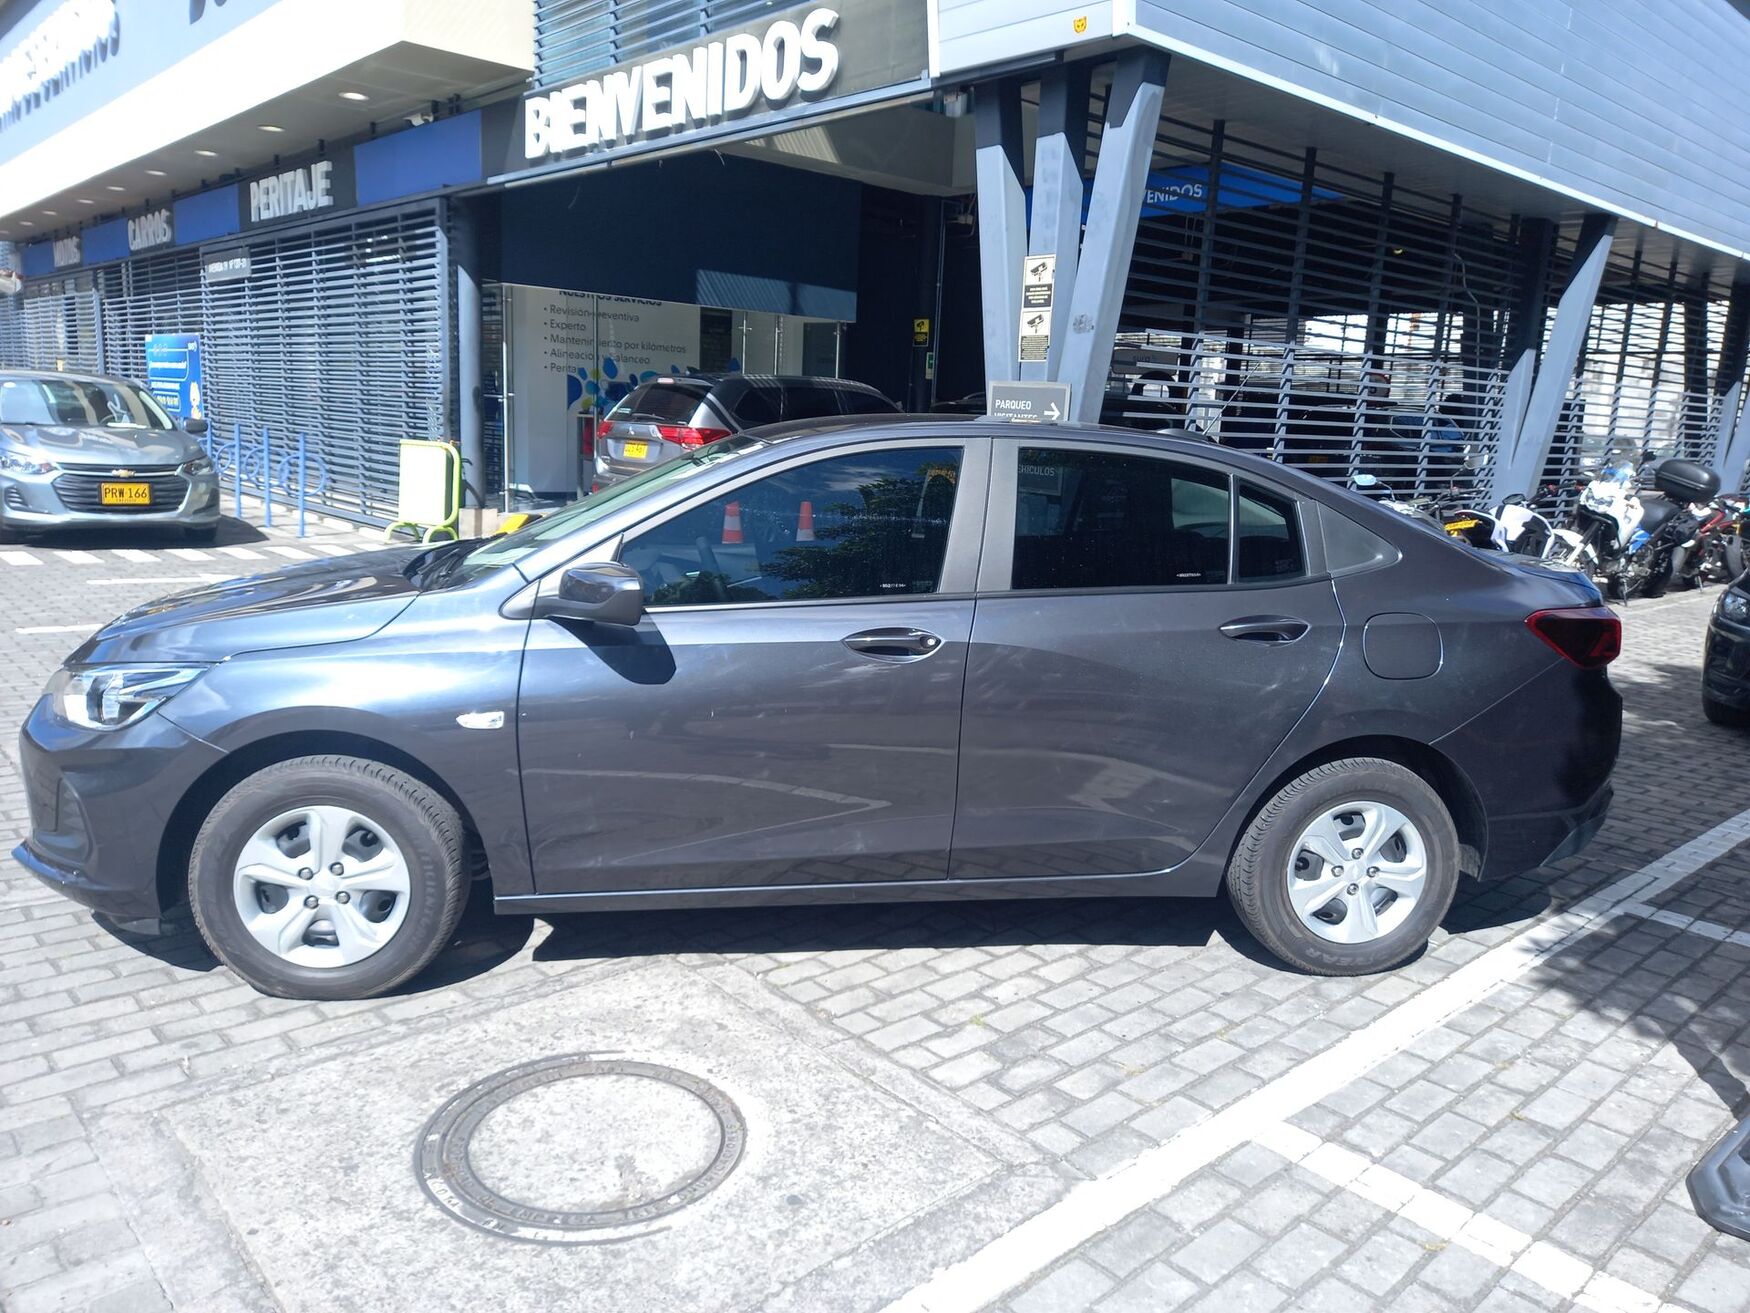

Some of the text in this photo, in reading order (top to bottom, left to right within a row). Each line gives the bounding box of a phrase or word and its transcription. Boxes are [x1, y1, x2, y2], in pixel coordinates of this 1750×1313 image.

[525, 8, 839, 160] BIENVENIDOS
[250, 160, 333, 222] PERITAJE
[1145, 183, 1202, 204] ENIDOS
[128, 208, 171, 251] CARROS
[550, 319, 587, 332] Experto
[624, 341, 639, 352] por
[550, 348, 599, 361] Alineació
[609, 352, 651, 365] alanceo
[995, 399, 1032, 410] PARQUEO
[104, 487, 148, 499] PRW 166
